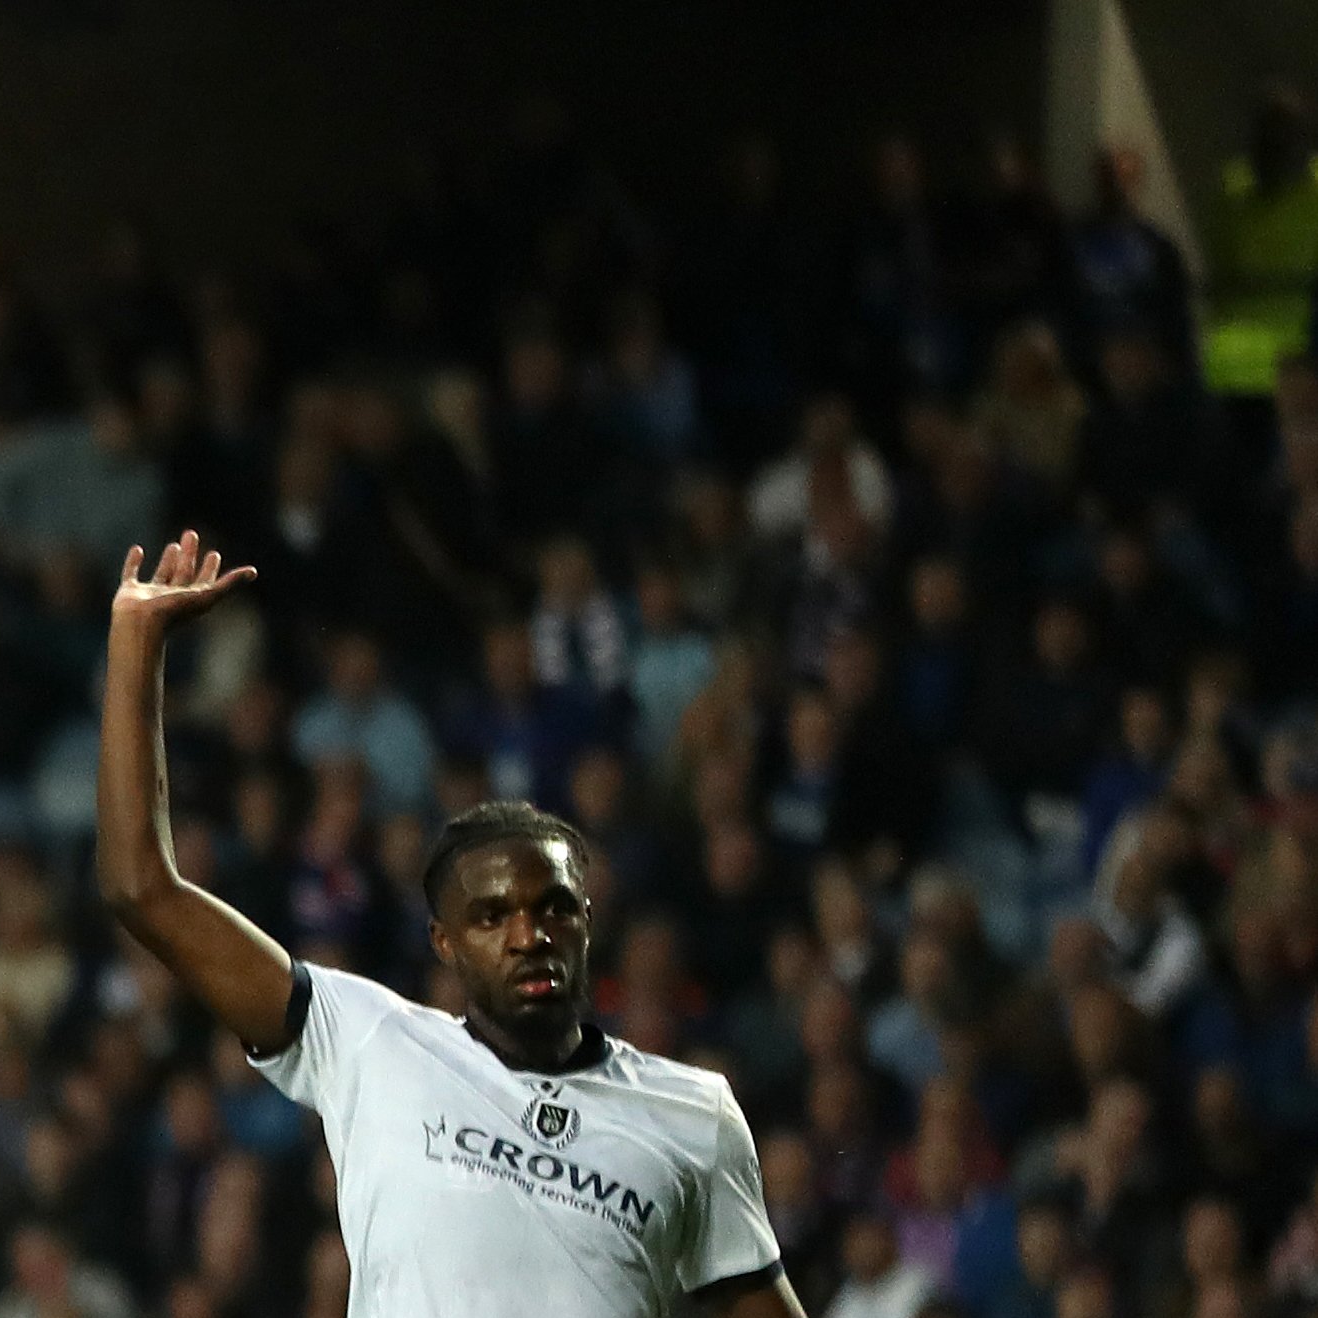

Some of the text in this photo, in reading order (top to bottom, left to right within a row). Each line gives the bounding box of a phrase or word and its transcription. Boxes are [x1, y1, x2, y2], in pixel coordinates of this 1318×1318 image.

[451, 1153, 535, 1195] engineering
[541, 1184, 597, 1215] services
[455, 1127, 654, 1224] CROWN
